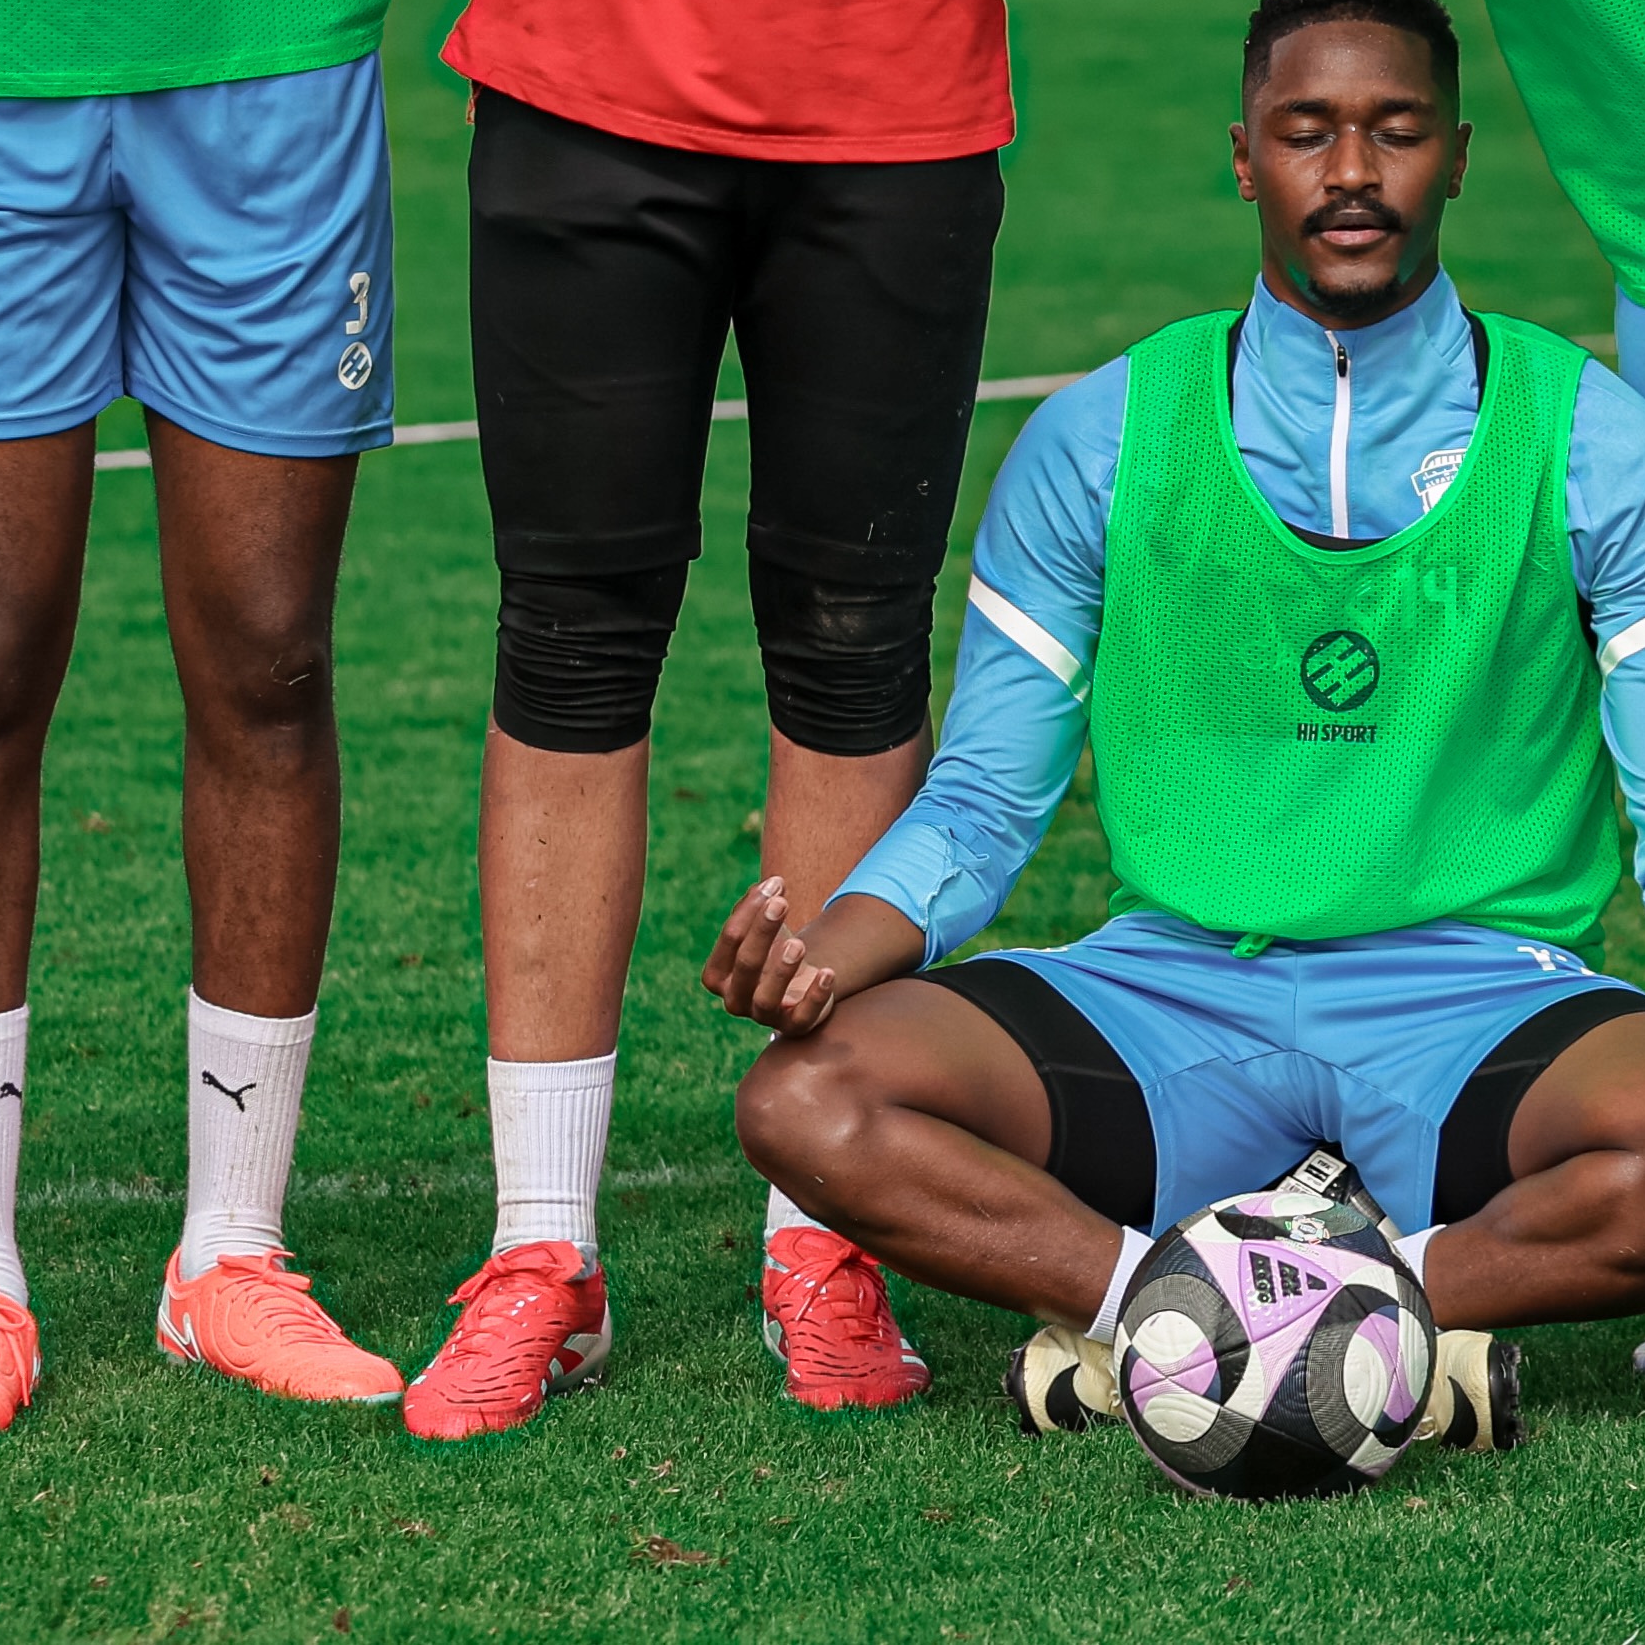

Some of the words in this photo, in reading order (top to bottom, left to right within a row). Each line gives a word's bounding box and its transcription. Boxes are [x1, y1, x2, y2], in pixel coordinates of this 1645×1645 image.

[345, 271, 371, 335] 3
[1296, 722, 1318, 742] HH
[1321, 723, 1378, 743] SPORT
